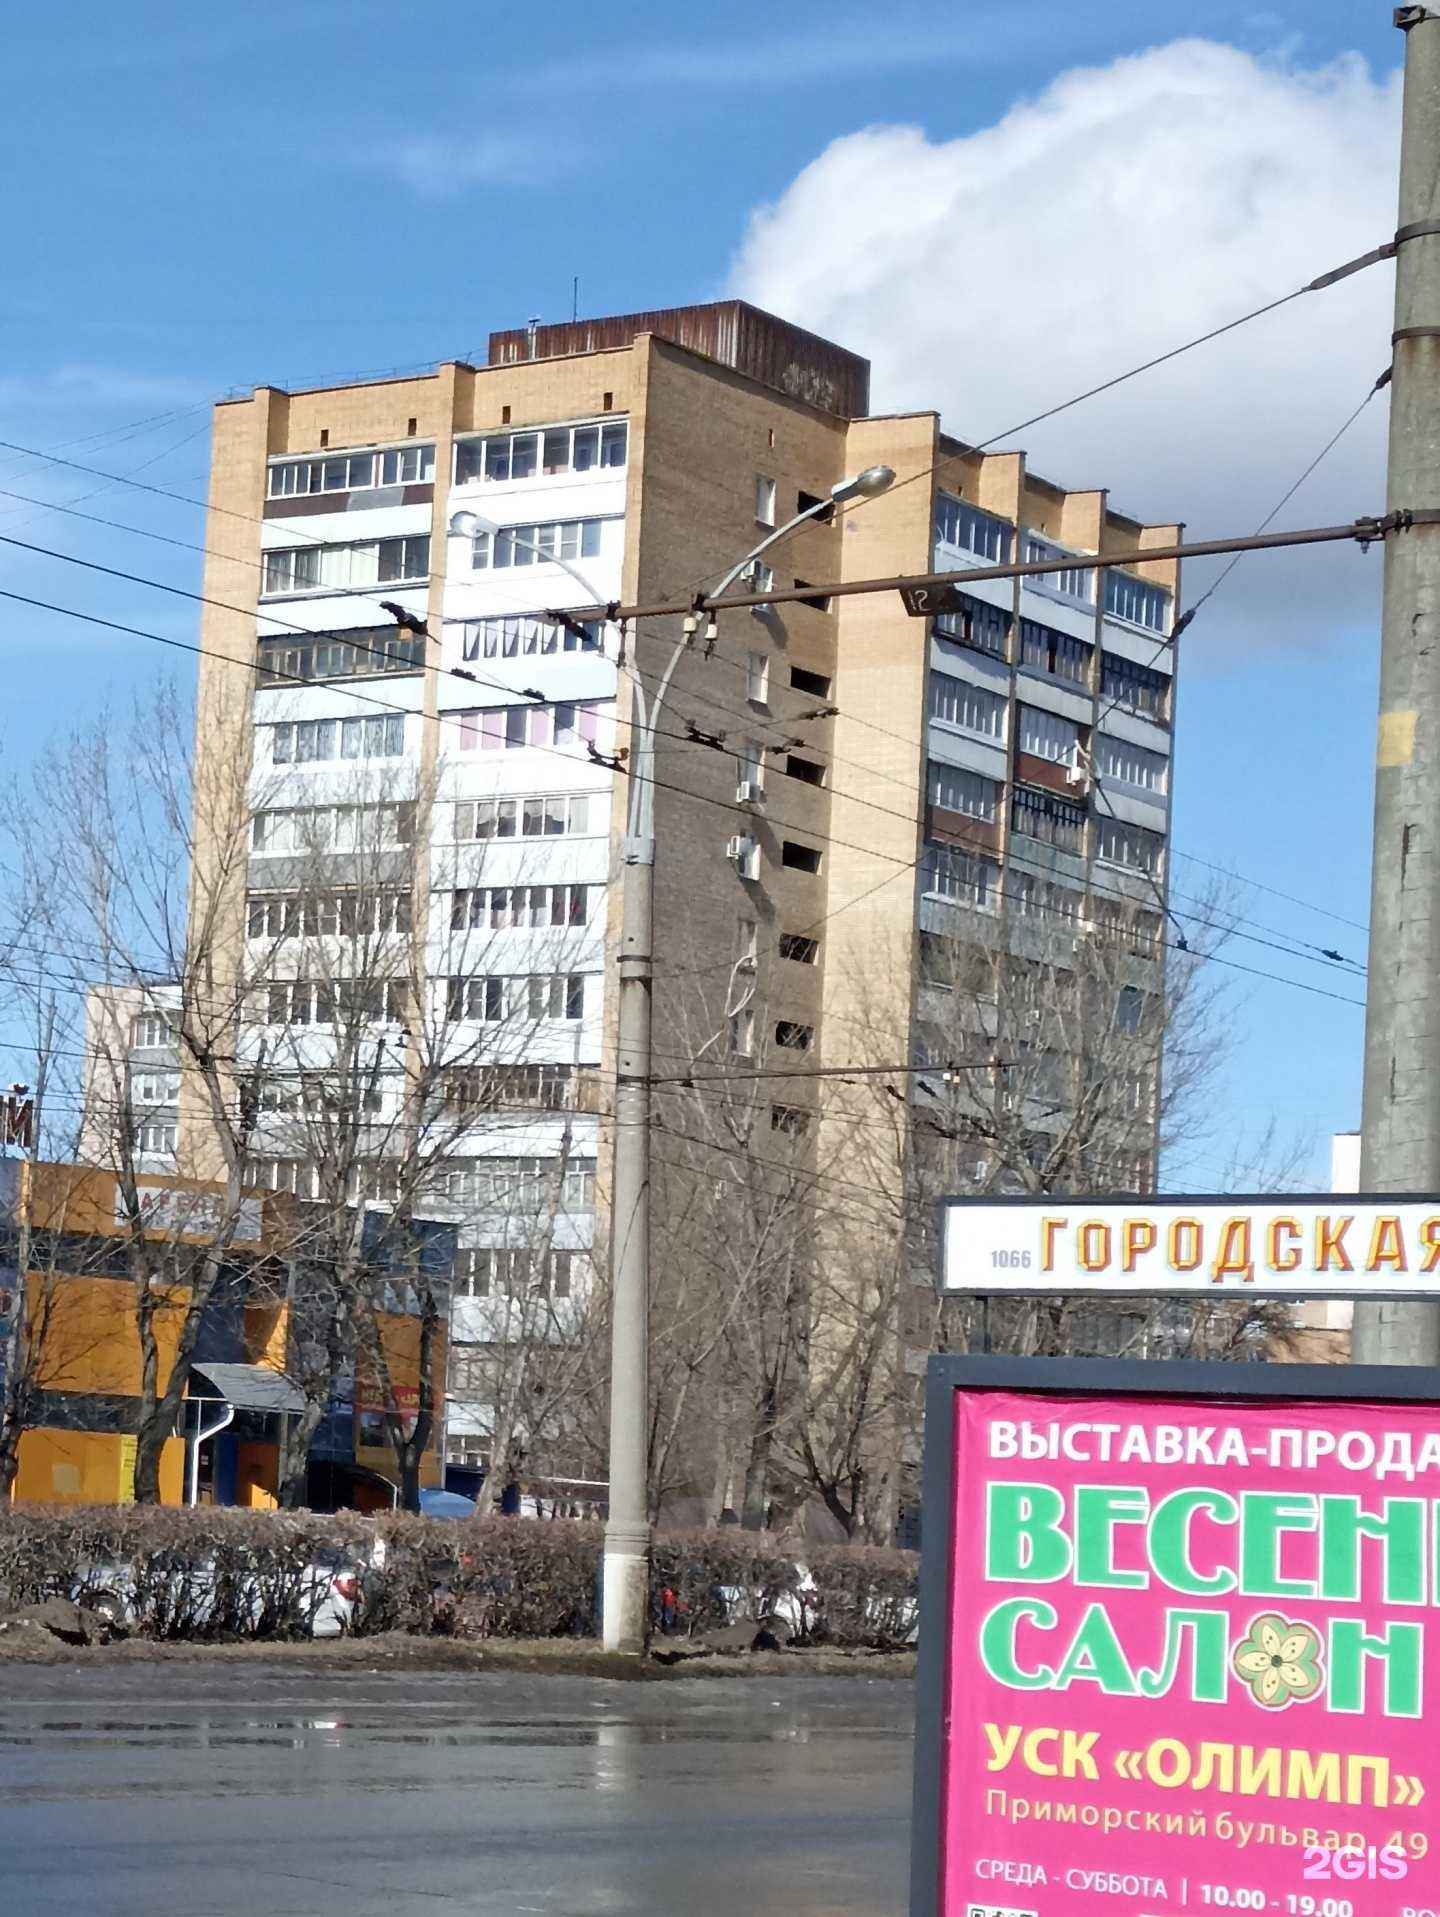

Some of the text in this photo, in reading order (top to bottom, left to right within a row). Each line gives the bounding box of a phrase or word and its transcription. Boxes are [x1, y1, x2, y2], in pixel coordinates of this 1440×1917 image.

[990, 1250, 1032, 1269] 1066
[1040, 1215, 1440, 1283] ГОРОДСКАЯ
[985, 1481, 1440, 1608] ВЕСЕН
[985, 1723, 1426, 1808] УСК «ОЛИМП»
[985, 1788, 1207, 1836] Приморский
[975, 1859, 1047, 1887] СРЕДА
[1066, 1868, 1168, 1899] СУББОТА
[1200, 1884, 1265, 1910] 10.00
[1286, 1894, 1354, 1917] 19.00
